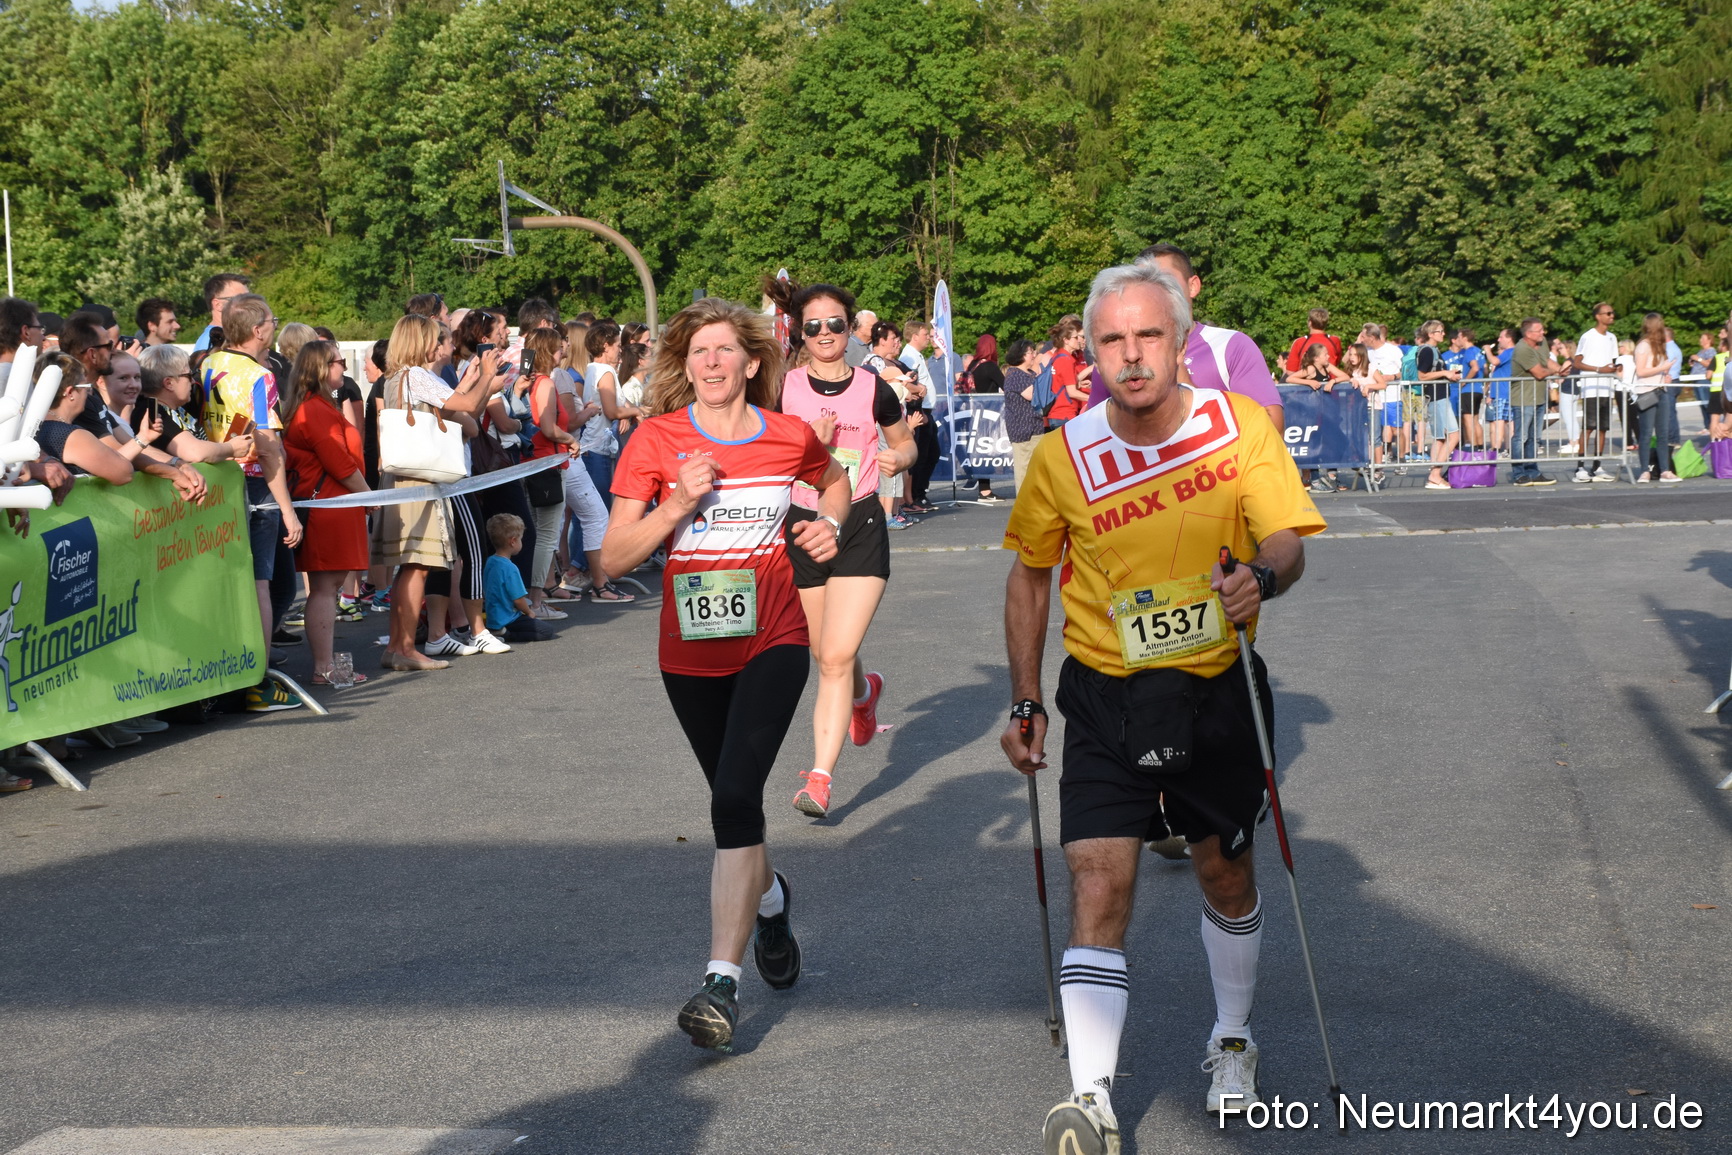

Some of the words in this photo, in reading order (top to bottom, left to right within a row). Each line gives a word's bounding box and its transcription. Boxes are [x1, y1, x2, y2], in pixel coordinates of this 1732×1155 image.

[821, 407, 837, 418] Die
[954, 430, 1013, 454] Fisc
[960, 457, 1015, 468] AUTOM
[133, 489, 187, 540] Gesunde
[1092, 489, 1168, 536] MAX
[156, 531, 194, 572] laufen
[194, 507, 241, 559] länger!
[57, 550, 92, 574] Fischer
[60, 565, 89, 582] AUTOMOBILE
[684, 593, 746, 621] 1836
[1129, 596, 1170, 612] firmenlauf
[20, 579, 140, 679] firmenlauf
[690, 619, 724, 628] Wolfsteiner
[725, 618, 742, 626] Timo
[1131, 601, 1208, 643] 1537
[1139, 651, 1150, 659] Max
[1151, 647, 1165, 657] Bögl
[1165, 641, 1195, 653] Bauservice
[1195, 636, 1212, 645] GmbH
[1145, 638, 1179, 651] Altmann
[1180, 632, 1204, 643] Anton
[23, 662, 79, 703] neumarkt
[113, 644, 257, 703] www.firmenlauf-oberpfalz.de
